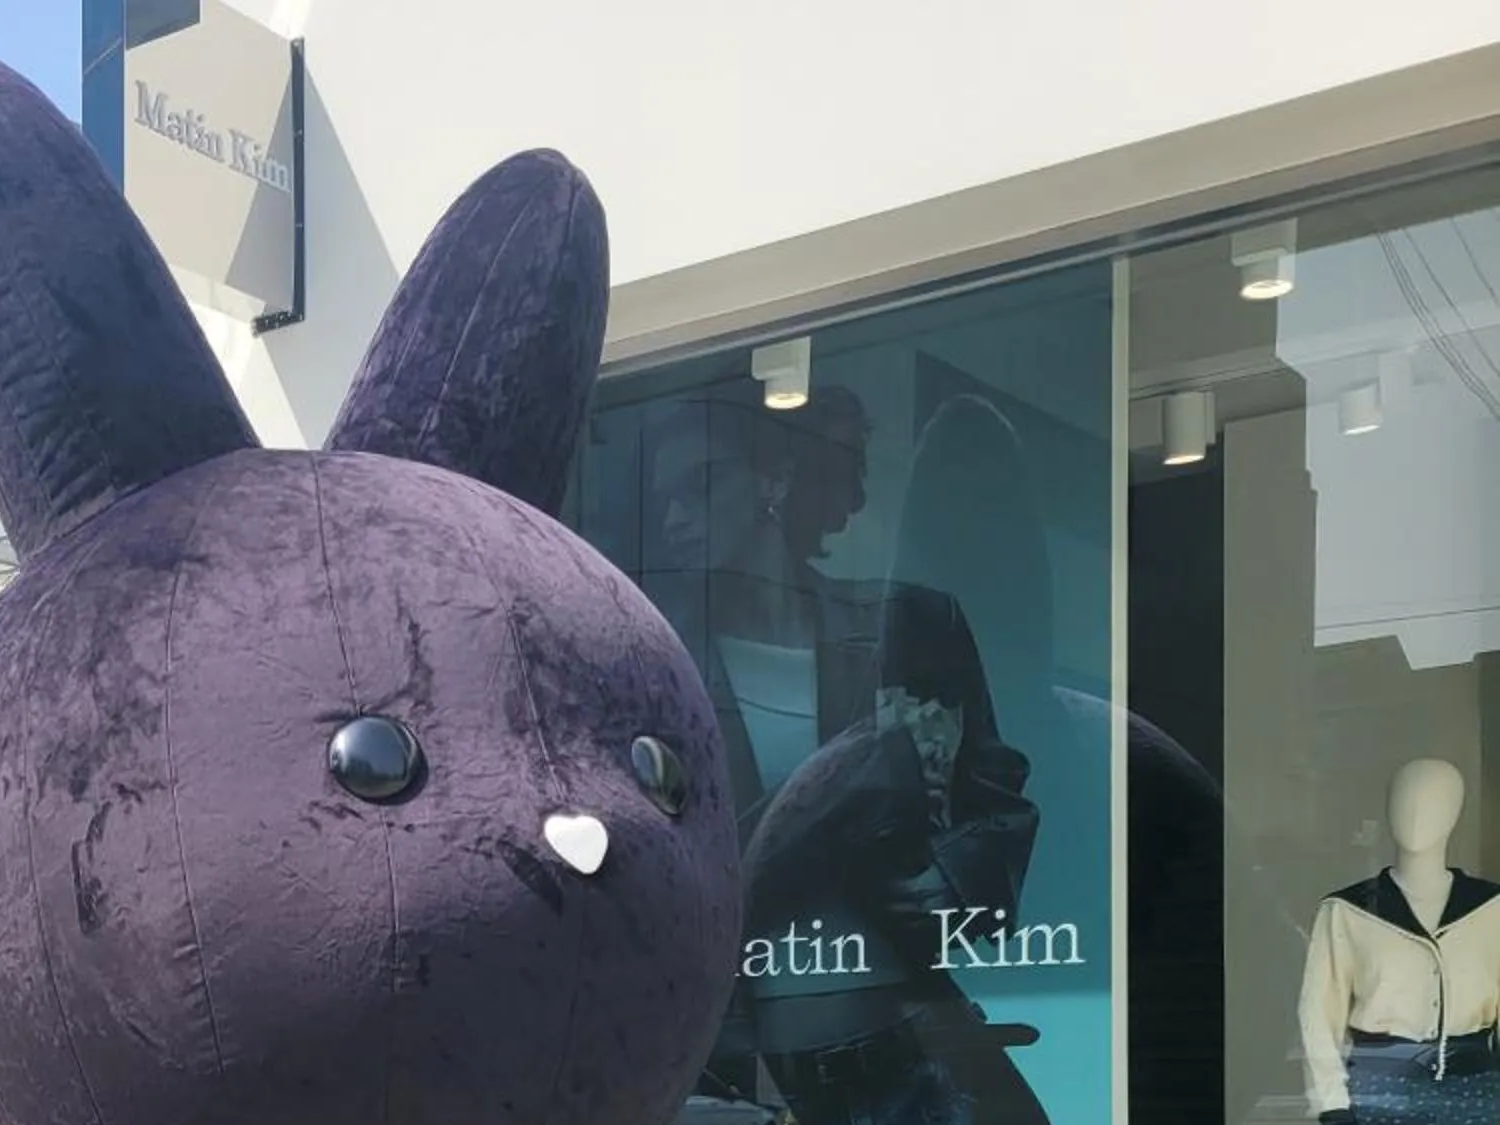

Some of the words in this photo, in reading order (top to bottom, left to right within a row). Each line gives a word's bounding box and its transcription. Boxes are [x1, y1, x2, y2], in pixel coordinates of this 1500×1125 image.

[134, 79, 225, 163] Matin
[228, 127, 292, 193] Kim
[735, 918, 871, 977] atin
[929, 907, 1087, 970] Kim
